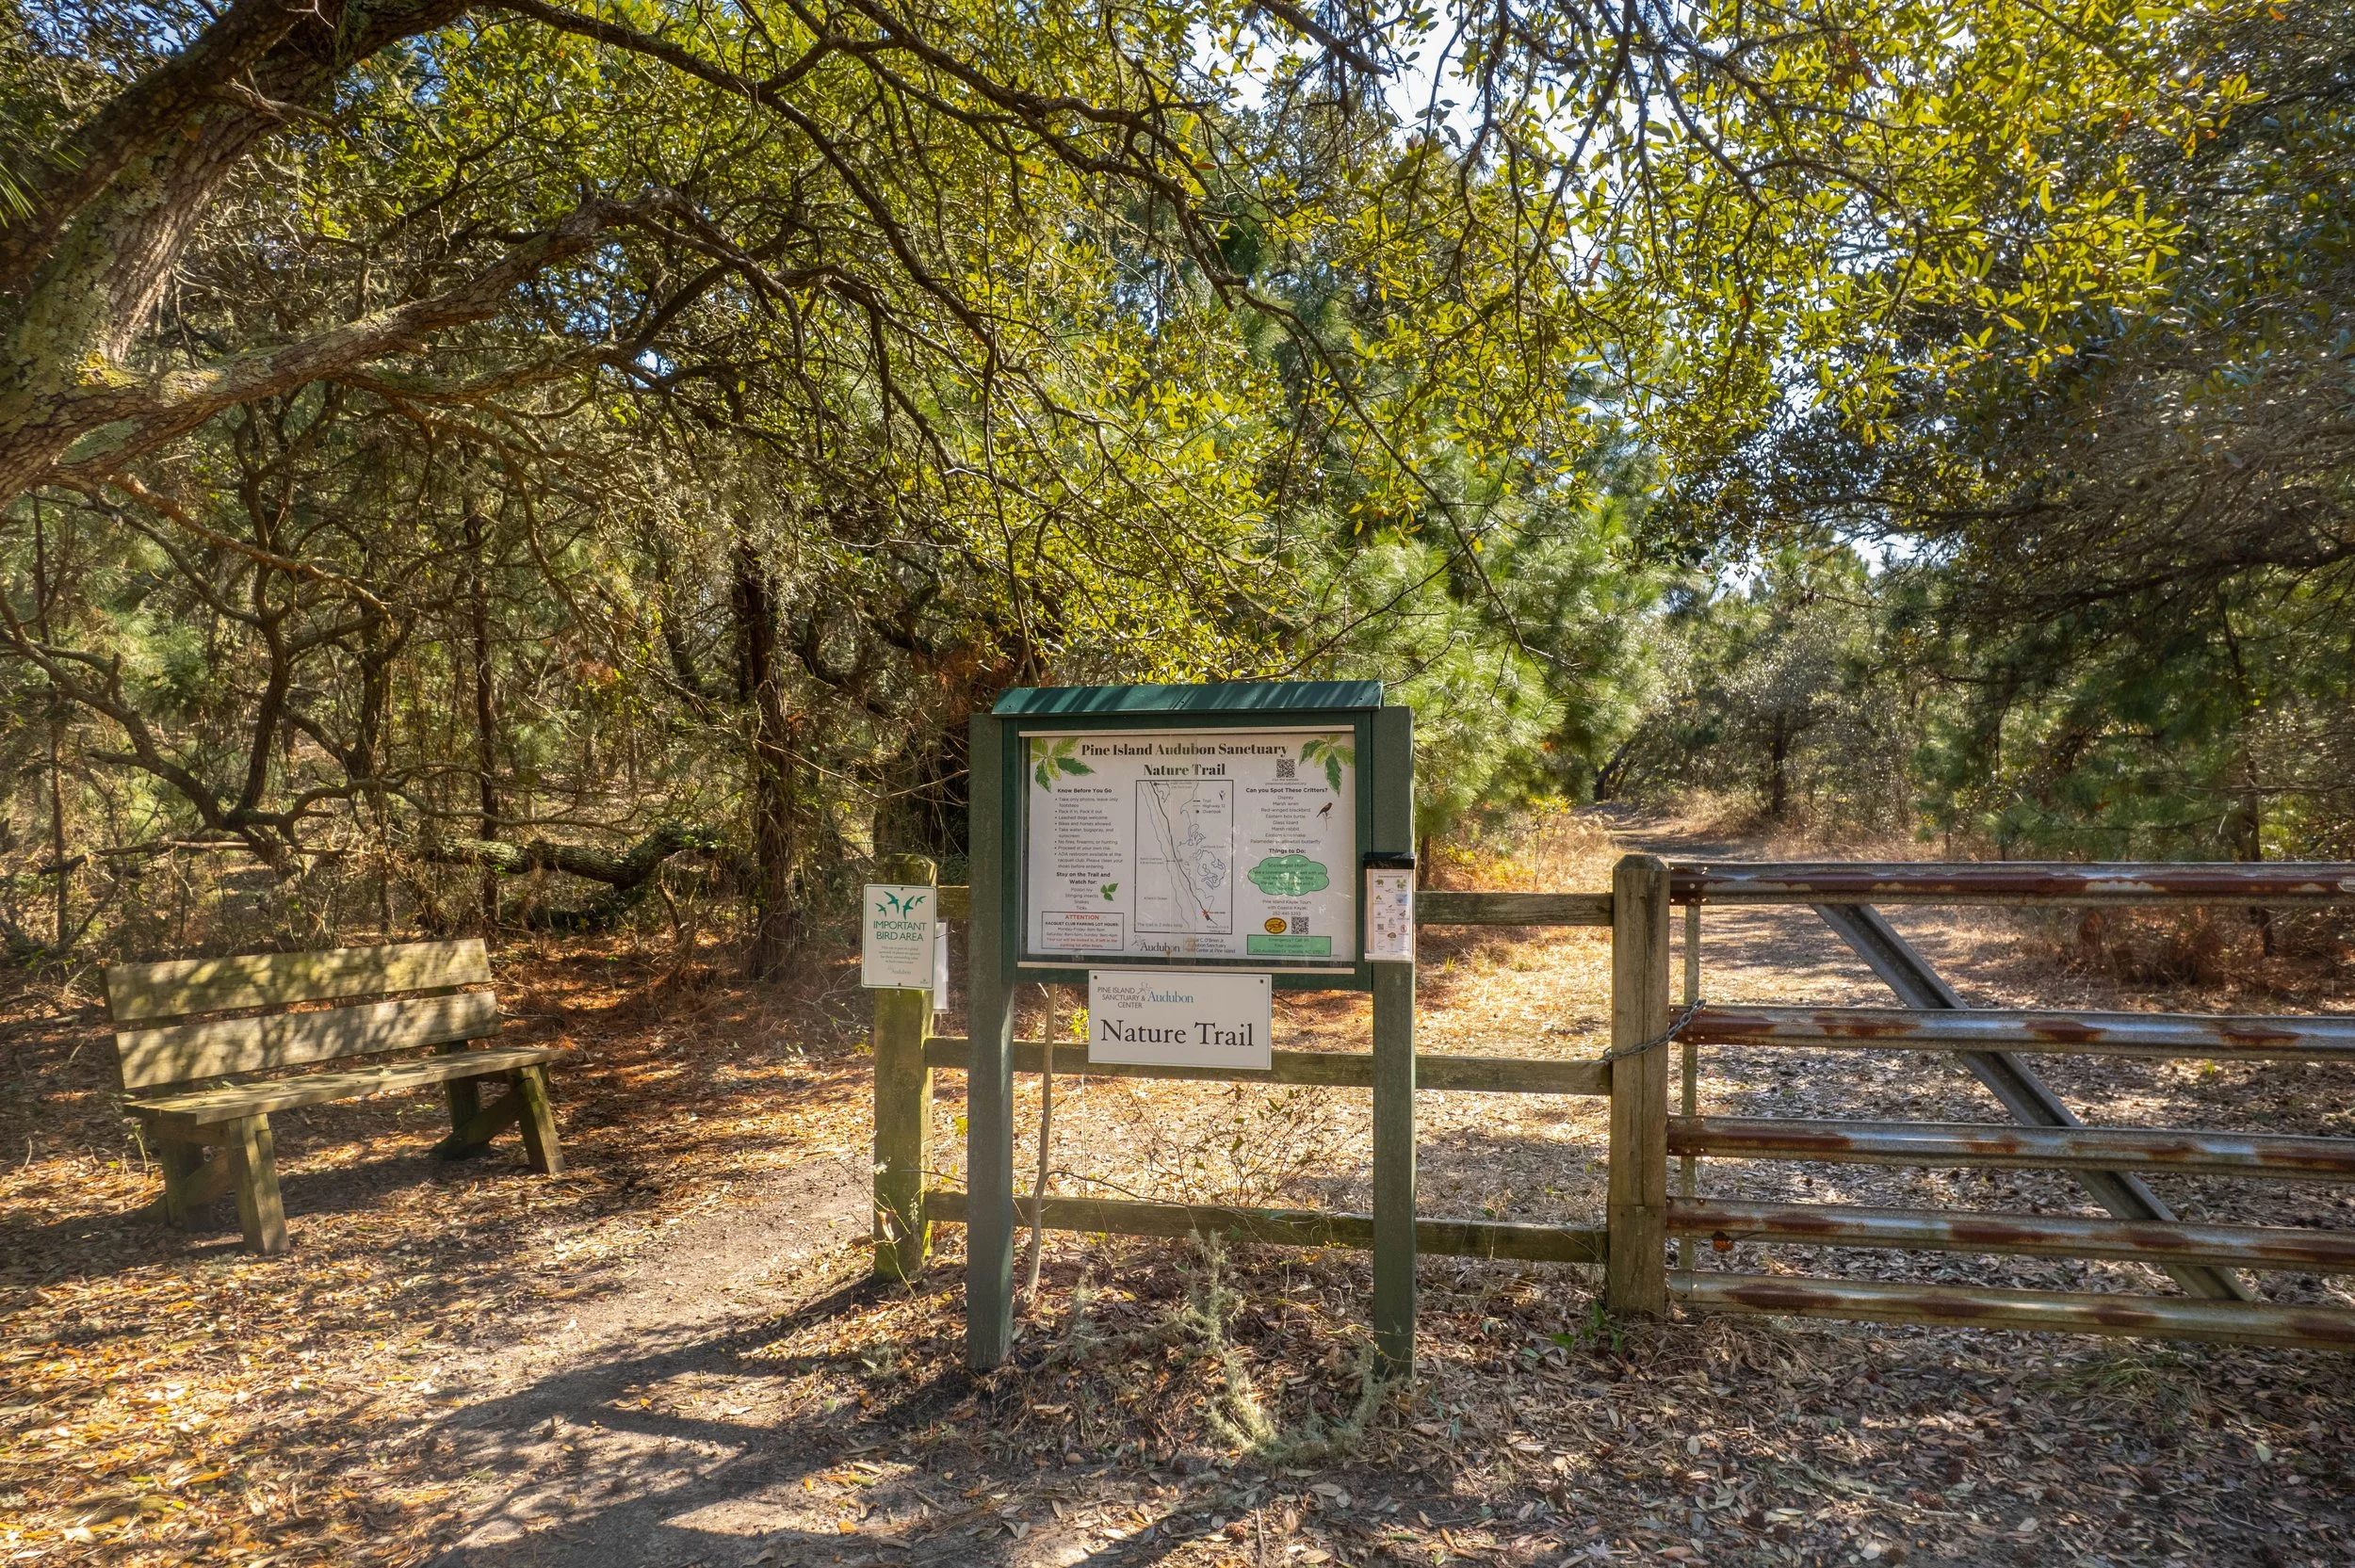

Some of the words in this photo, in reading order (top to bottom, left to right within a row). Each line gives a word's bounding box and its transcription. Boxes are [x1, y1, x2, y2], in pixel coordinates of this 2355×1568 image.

[1081, 743, 1111, 756] Pine
[1113, 743, 1153, 756] Island
[1155, 742, 1215, 755] Audubon
[1218, 743, 1289, 758] Sanctuary
[1144, 763, 1190, 776] Nature
[1192, 763, 1226, 776] Trail
[873, 920, 927, 930] IMPORTANT
[876, 931, 898, 941] BIRD
[900, 932, 924, 942] AREA
[1140, 941, 1180, 952] Audubon
[1147, 990, 1194, 1003] Audubon
[1100, 1019, 1186, 1044] Nature
[1194, 1021, 1254, 1046] Trail
